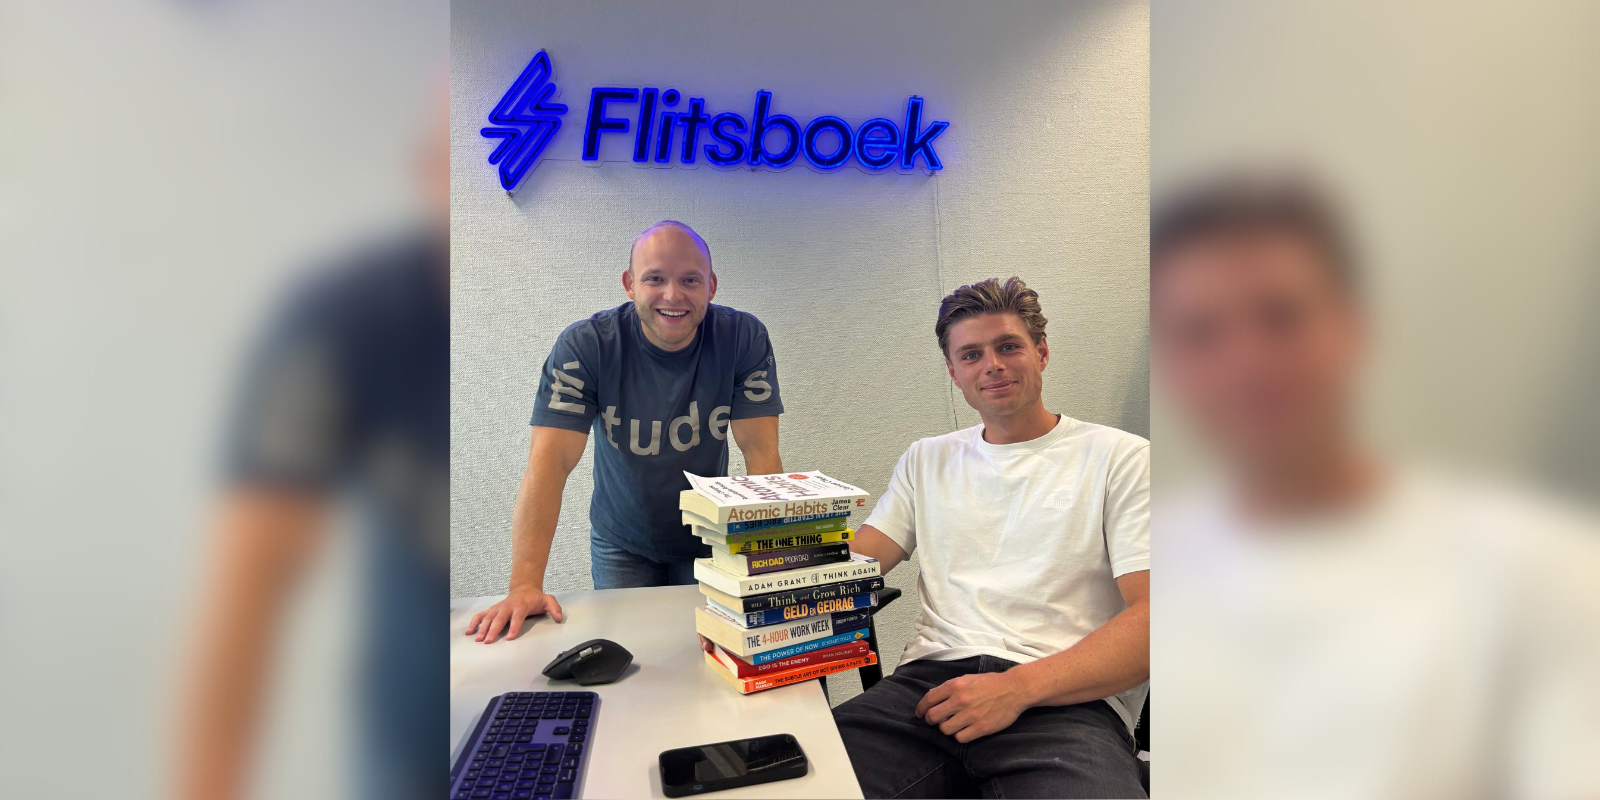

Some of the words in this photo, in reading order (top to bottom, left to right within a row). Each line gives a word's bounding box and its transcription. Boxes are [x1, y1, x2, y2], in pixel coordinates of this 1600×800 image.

[582, 87, 950, 170] Flitsboek
[727, 505, 781, 522] Atomic
[785, 501, 828, 517] Habits
[831, 498, 851, 506] James
[744, 520, 763, 530] RIES
[757, 539, 774, 550] THE
[775, 537, 794, 548] ONE
[795, 533, 823, 546] THING
[751, 559, 769, 569] RICH
[769, 557, 785, 567] DAD
[748, 582, 773, 591] ADAM
[777, 577, 807, 587] GRANT
[823, 571, 848, 580] THINK
[852, 567, 876, 576] AGAIN
[768, 594, 797, 608] Think
[812, 589, 836, 600] Grow
[839, 583, 861, 596] Rich
[783, 603, 809, 620] GELD
[816, 596, 855, 614] GEDRAG
[747, 635, 761, 649] THE
[762, 629, 789, 645] 4-HOUR
[789, 623, 811, 638] WORK
[810, 619, 830, 634] WEEK
[760, 654, 773, 662] THE
[772, 648, 795, 659] POWER
[795, 645, 804, 653] OF
[804, 642, 819, 651] NOW
[790, 657, 810, 665] ENEMY
